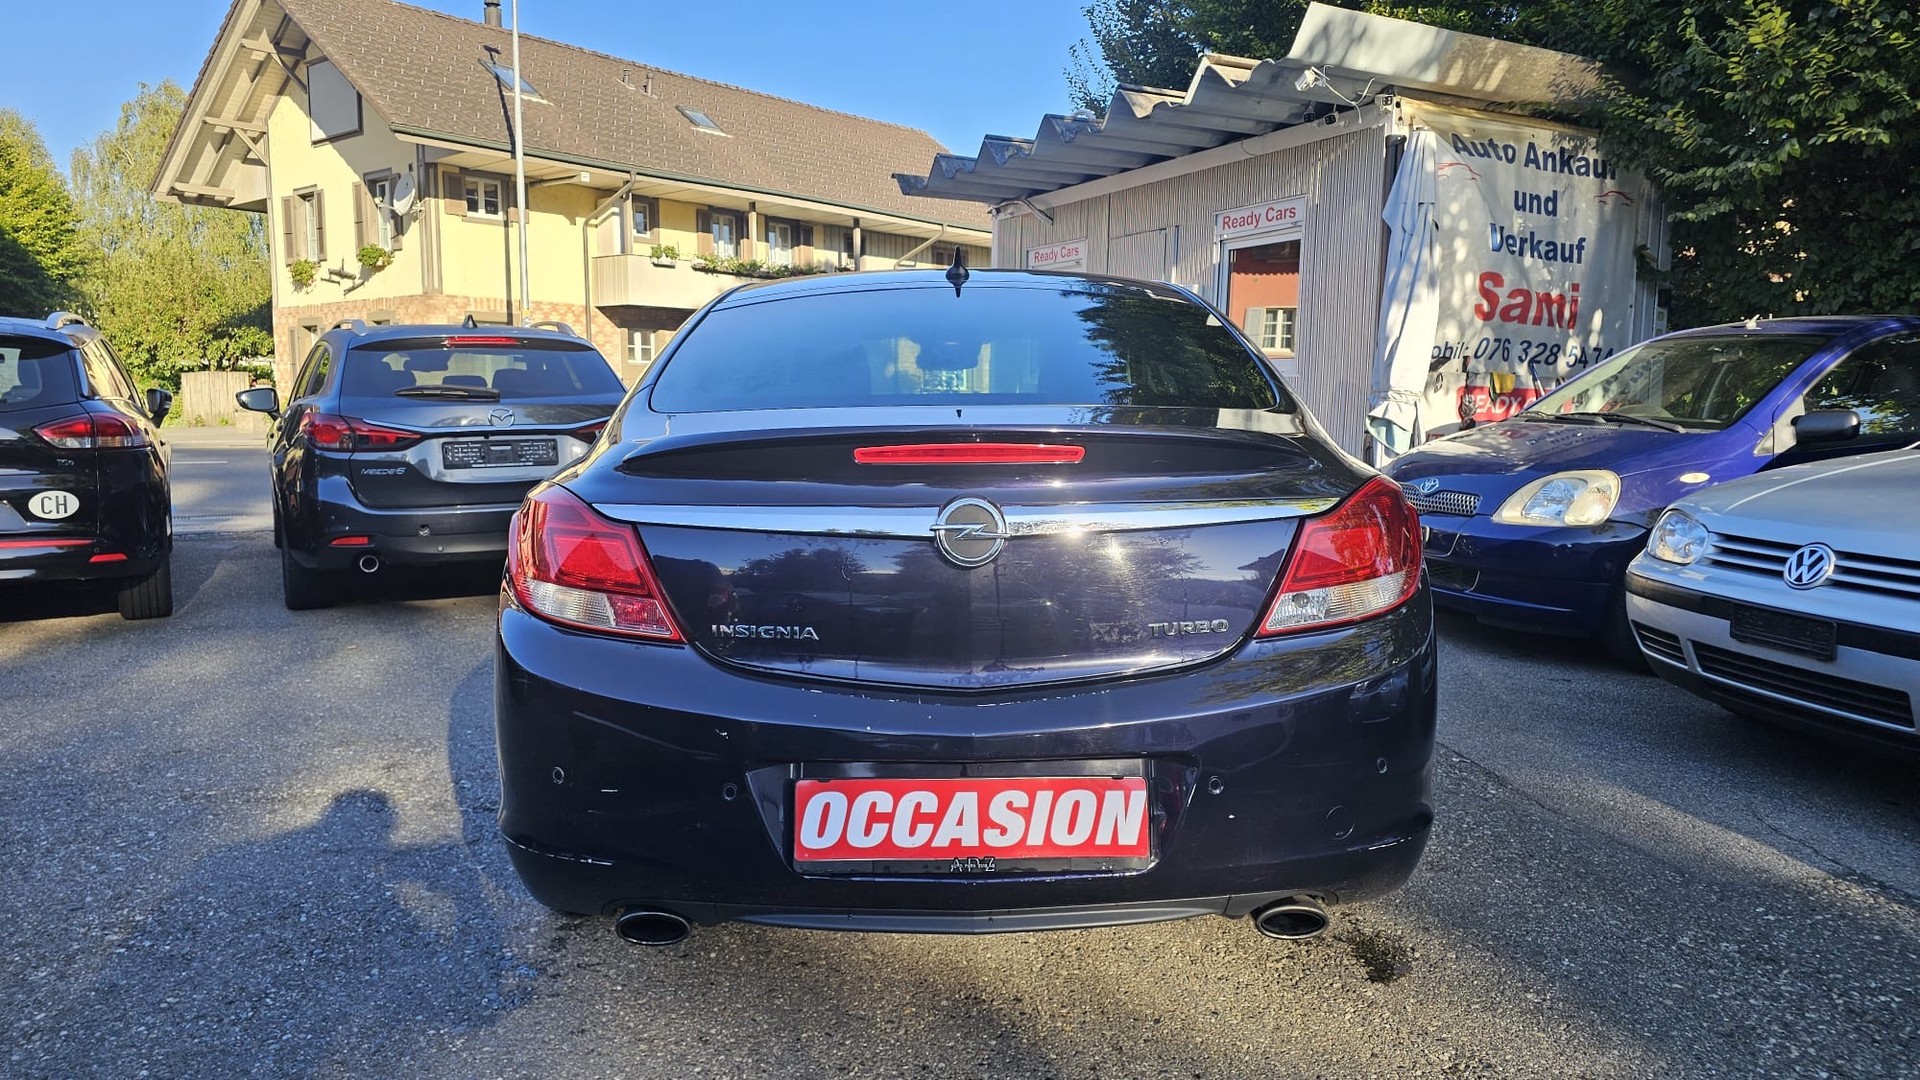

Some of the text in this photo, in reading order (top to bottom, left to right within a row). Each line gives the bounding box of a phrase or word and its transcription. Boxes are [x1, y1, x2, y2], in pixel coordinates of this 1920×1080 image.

[1451, 133, 1516, 164] Auto
[1514, 190, 1558, 217] und
[1222, 206, 1296, 230] Ready Cars
[1034, 246, 1080, 263] Ready Cars
[1490, 222, 1586, 264] Verkauf
[1474, 271, 1580, 330] Sami
[1473, 337, 1511, 362] 076
[1518, 340, 1561, 366] 328
[1463, 393, 1522, 417] EADY
[41, 495, 68, 515] CH
[711, 624, 819, 640] INSIGNIA
[1148, 619, 1229, 637] TURBO
[800, 788, 1147, 849] OCCASION
